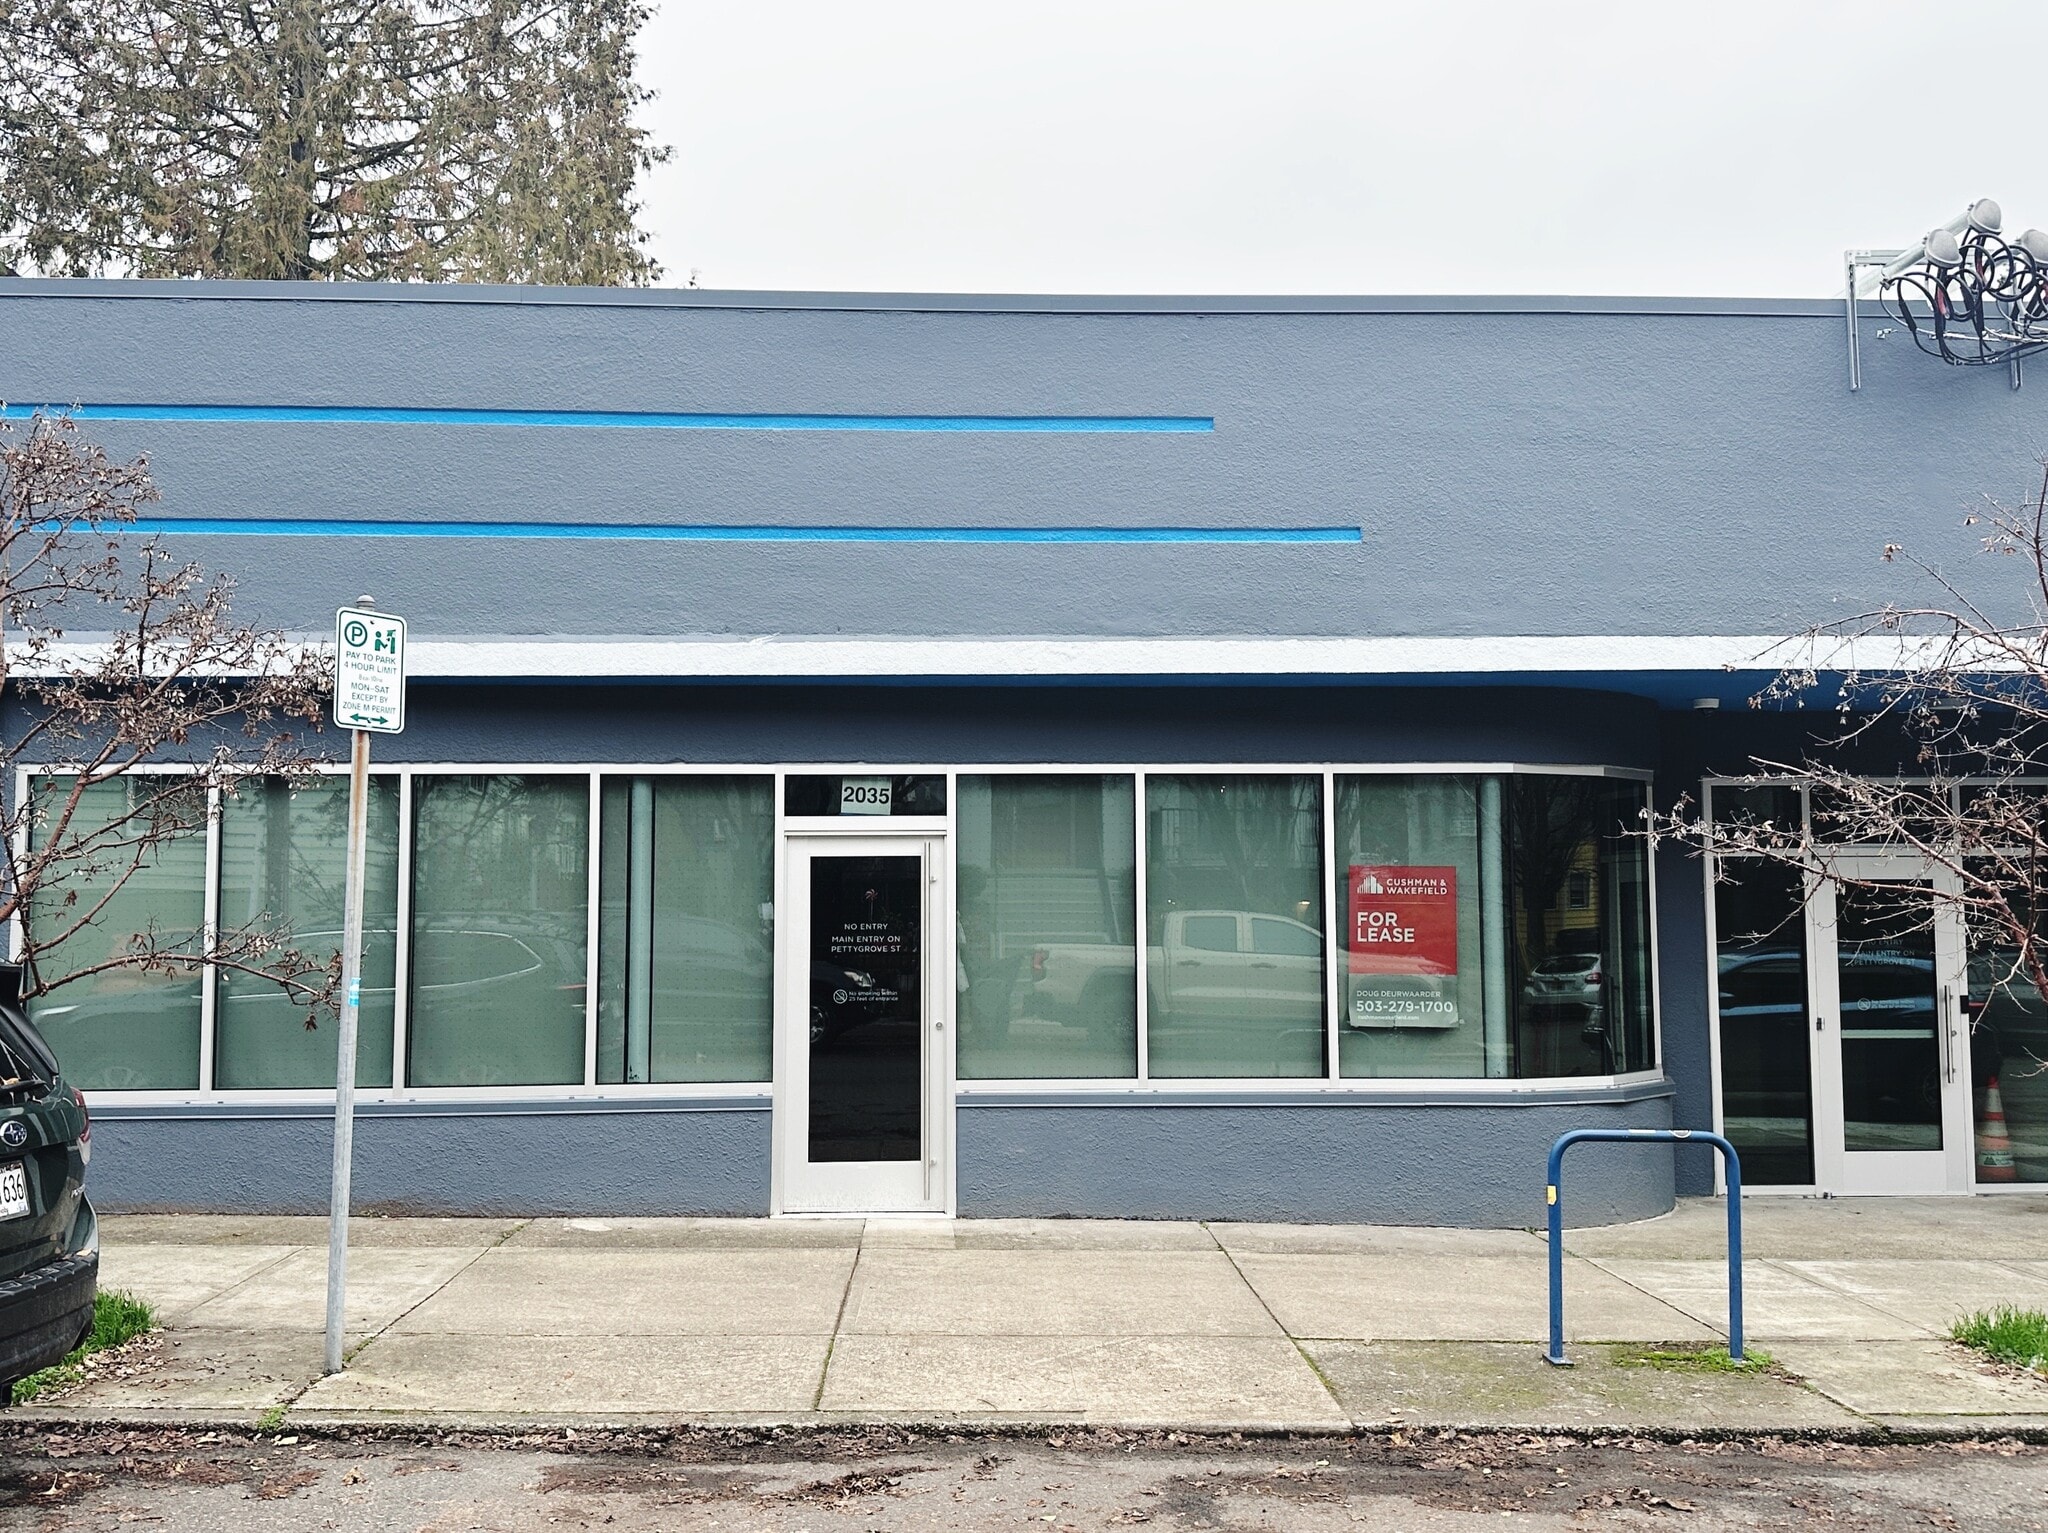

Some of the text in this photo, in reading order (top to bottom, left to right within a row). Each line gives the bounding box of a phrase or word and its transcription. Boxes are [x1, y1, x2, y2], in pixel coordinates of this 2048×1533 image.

[352, 626, 363, 642] P
[346, 651, 396, 665] PAY TO PARK
[351, 662, 374, 671] HOUR
[377, 665, 397, 675] LIMIT
[351, 692, 388, 704] EXCEPT BY
[343, 701, 361, 710] ZONE
[372, 705, 396, 714] PERMIT
[843, 786, 890, 804] 2035
[1386, 878, 1447, 887] CUSHMAN &
[1386, 887, 1448, 895] WAKEFIELD
[1357, 911, 1398, 927] FOR
[831, 935, 901, 943] MAIN ENTRY ON
[1357, 927, 1415, 943] LEASE
[831, 945, 901, 953] PETTYGROVE ST
[1356, 990, 1441, 998] DOUG DEURWAARDER
[1356, 1001, 1454, 1013] 503-279-1700
[0, 1173, 24, 1204] 636
